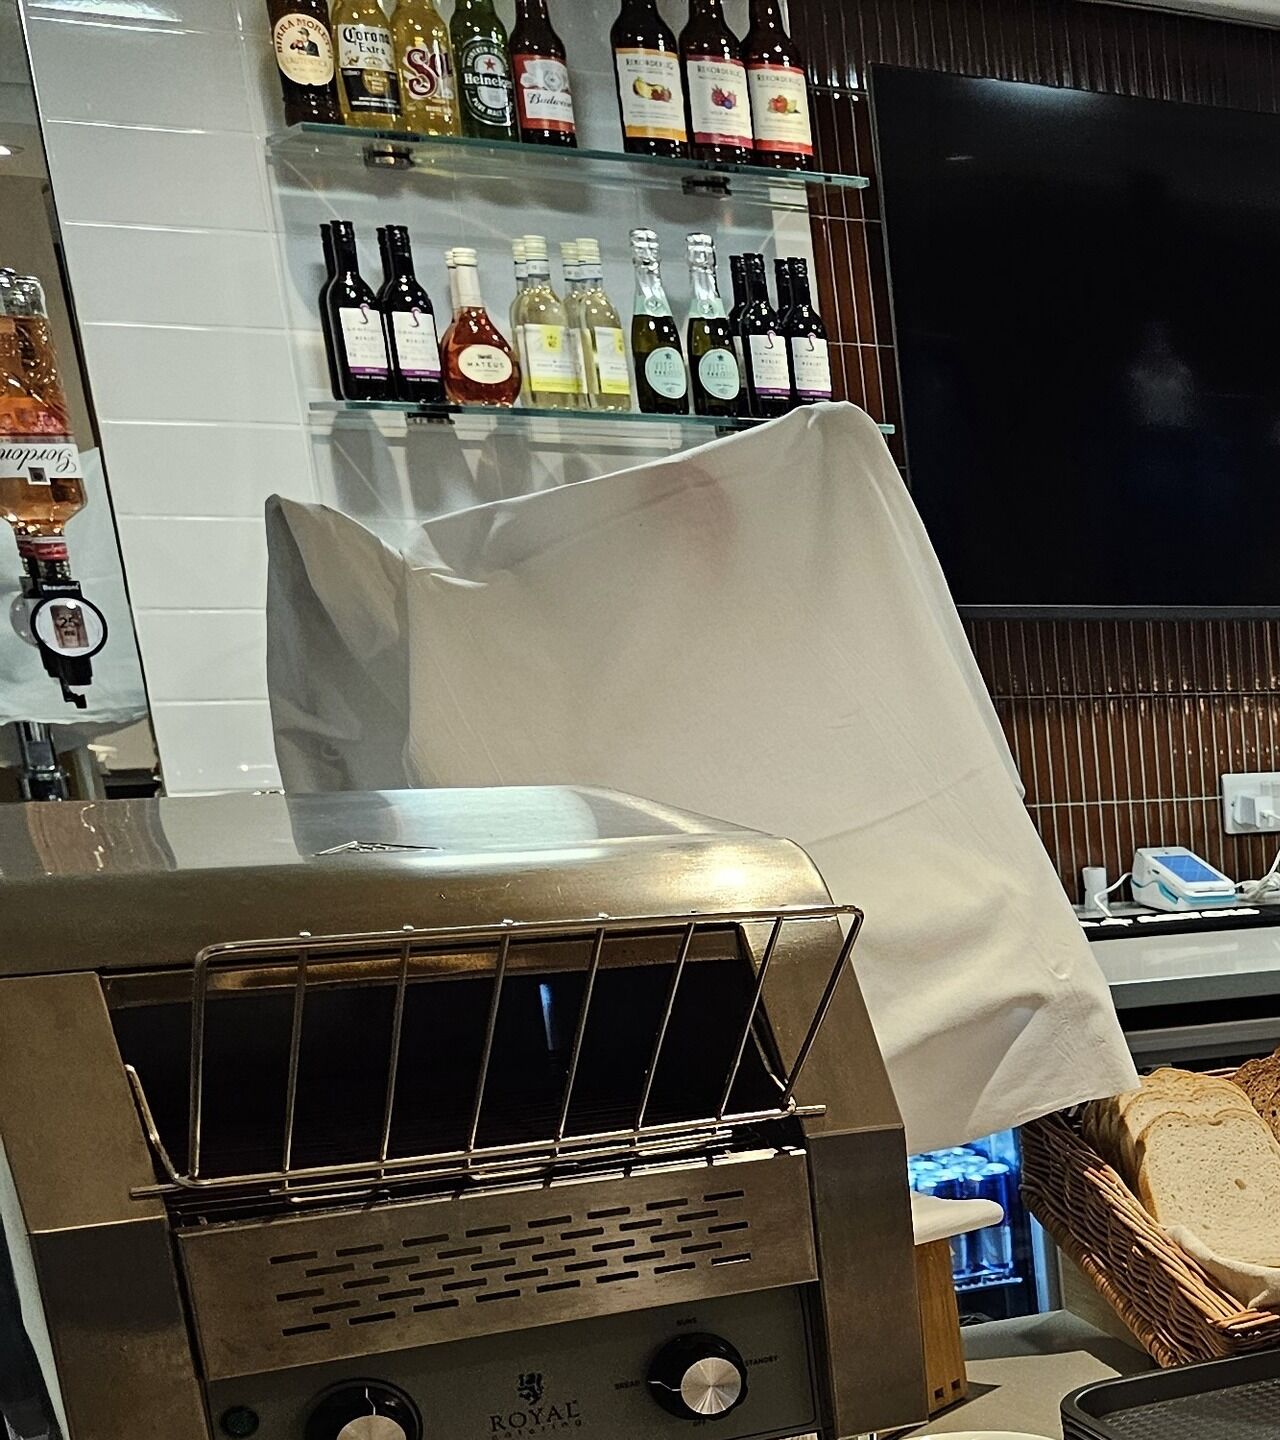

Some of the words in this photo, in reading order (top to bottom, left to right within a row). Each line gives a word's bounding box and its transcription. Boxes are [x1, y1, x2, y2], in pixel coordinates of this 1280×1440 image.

[467, 361, 505, 369] MATEUS
[676, 1317, 697, 1327] BUNS
[745, 1355, 779, 1367] STANDBY
[614, 1379, 641, 1390] BREAD
[490, 1400, 581, 1433] ROYAL
